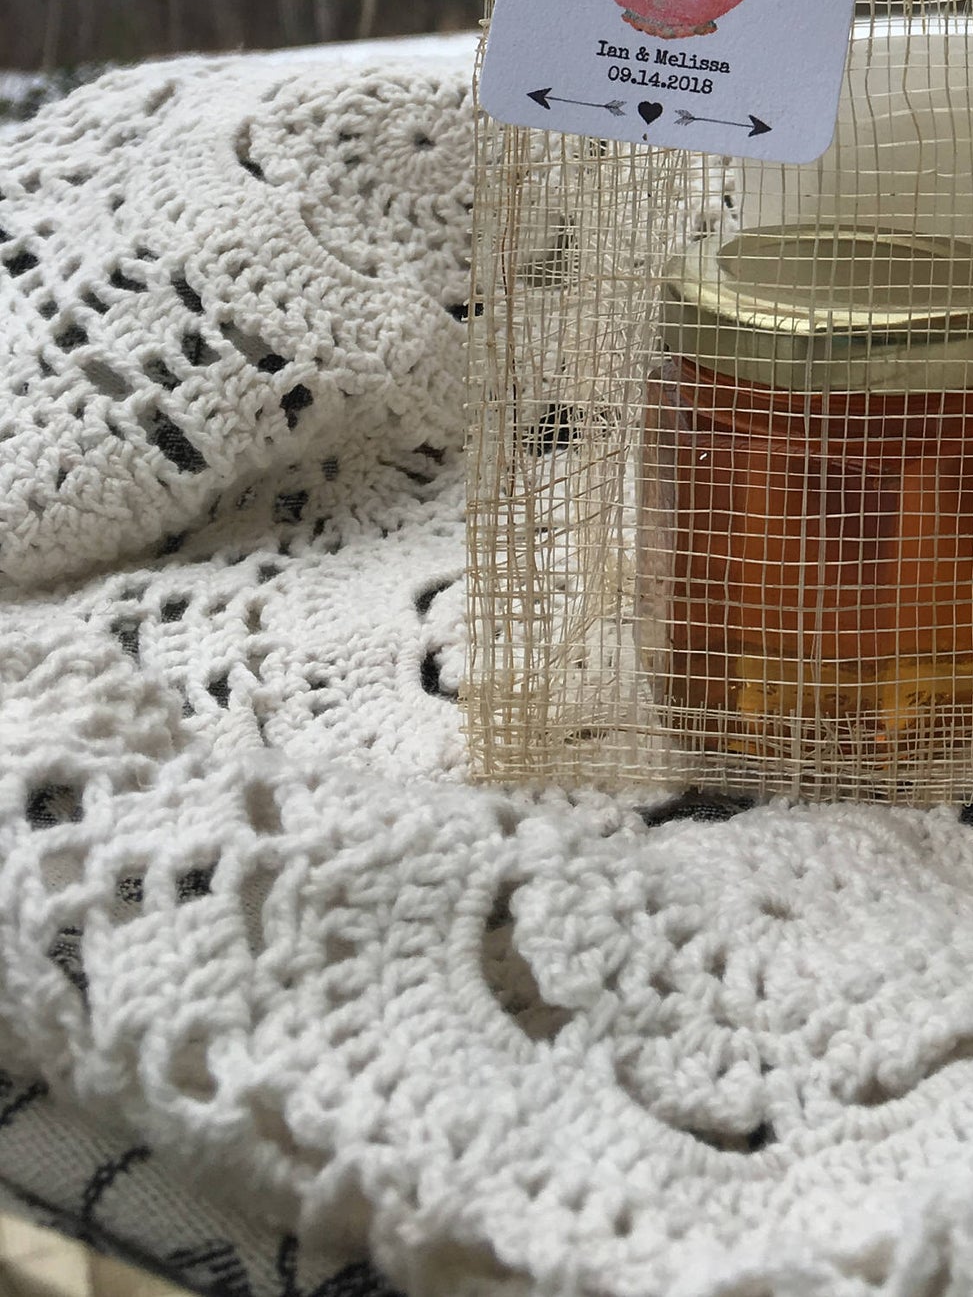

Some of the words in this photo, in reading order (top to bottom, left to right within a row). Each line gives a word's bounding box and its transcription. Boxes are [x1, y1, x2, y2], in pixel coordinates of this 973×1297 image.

[596, 40, 630, 60] Ian
[635, 46, 651, 63] &
[653, 48, 731, 74] Melissa
[607, 65, 713, 95] 09.14.2018
